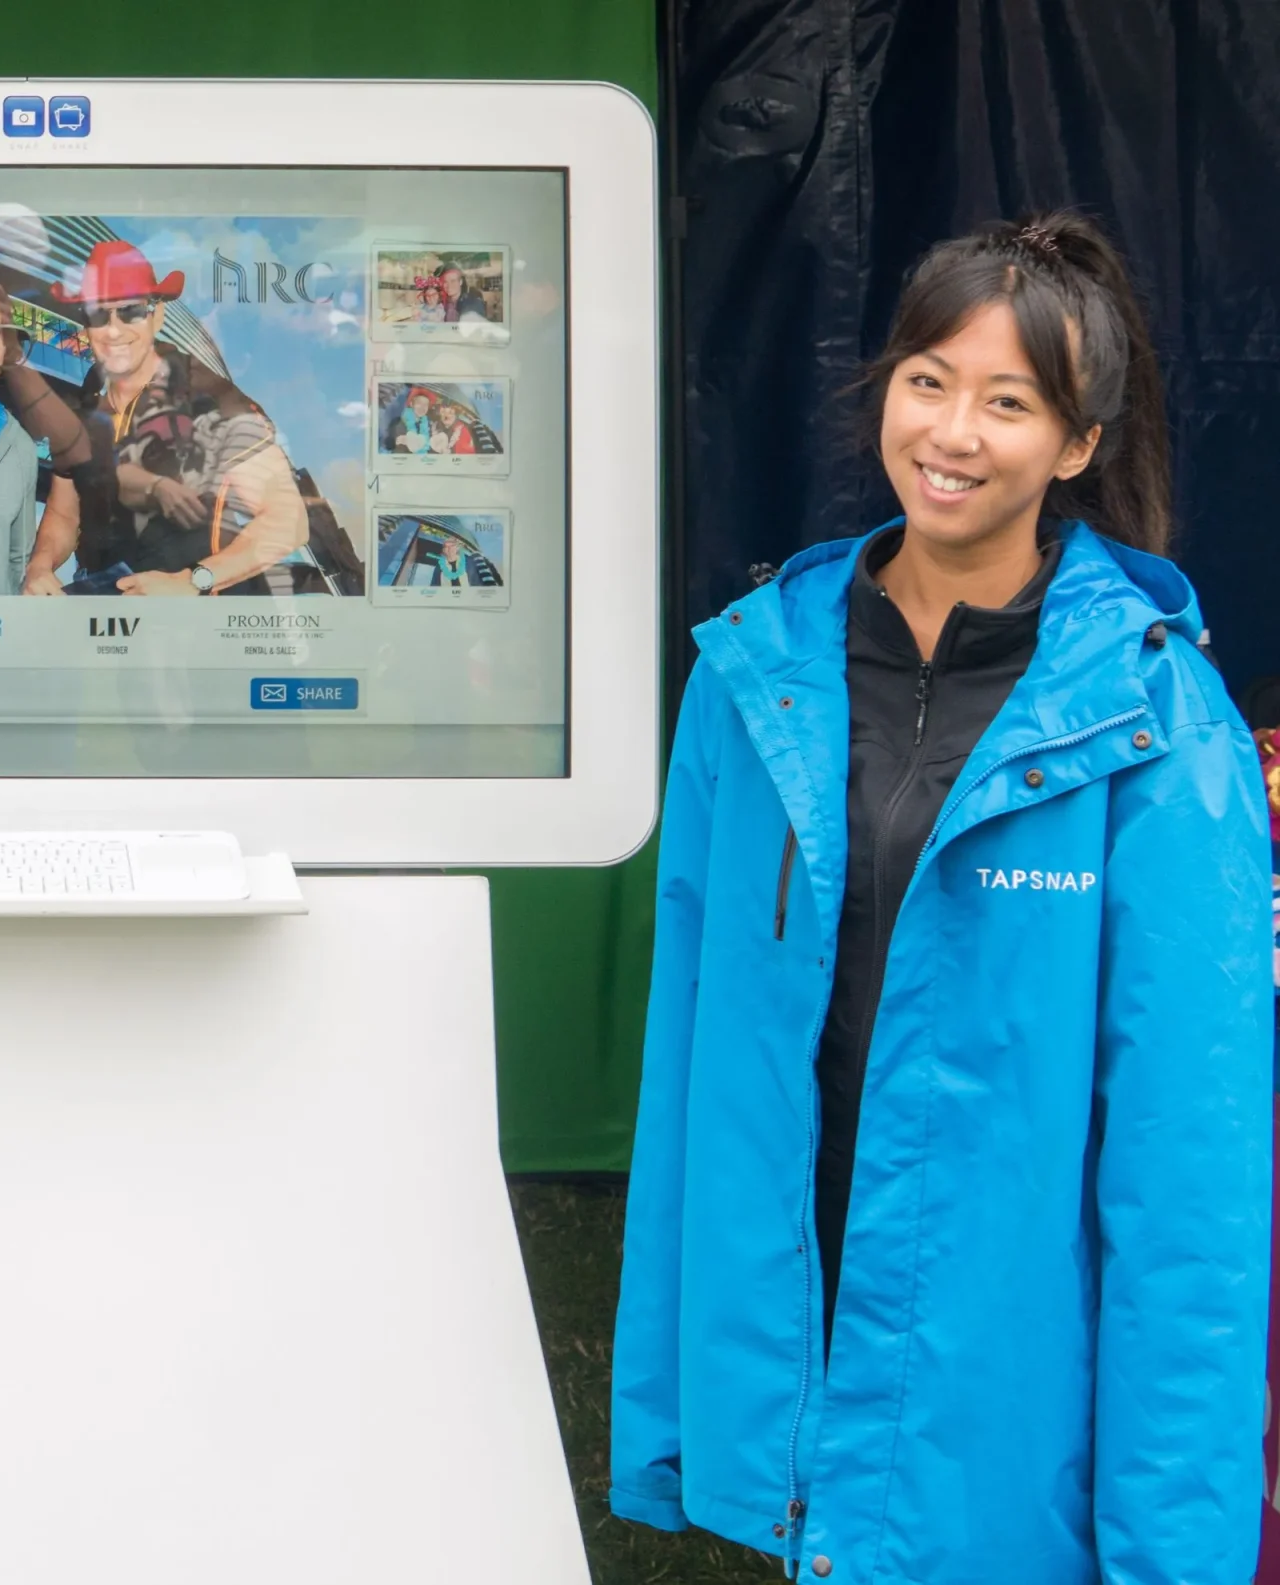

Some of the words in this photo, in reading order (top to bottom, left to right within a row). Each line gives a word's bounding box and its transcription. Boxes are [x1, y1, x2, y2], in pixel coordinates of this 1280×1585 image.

[212, 247, 335, 304] ARC
[89, 617, 141, 637] LIV
[227, 613, 321, 628] PROMPTON
[96, 645, 129, 655] DESIGNER
[276, 646, 297, 655] SALES
[296, 687, 343, 700] SHARE
[976, 868, 1096, 892] TAPSNAP
